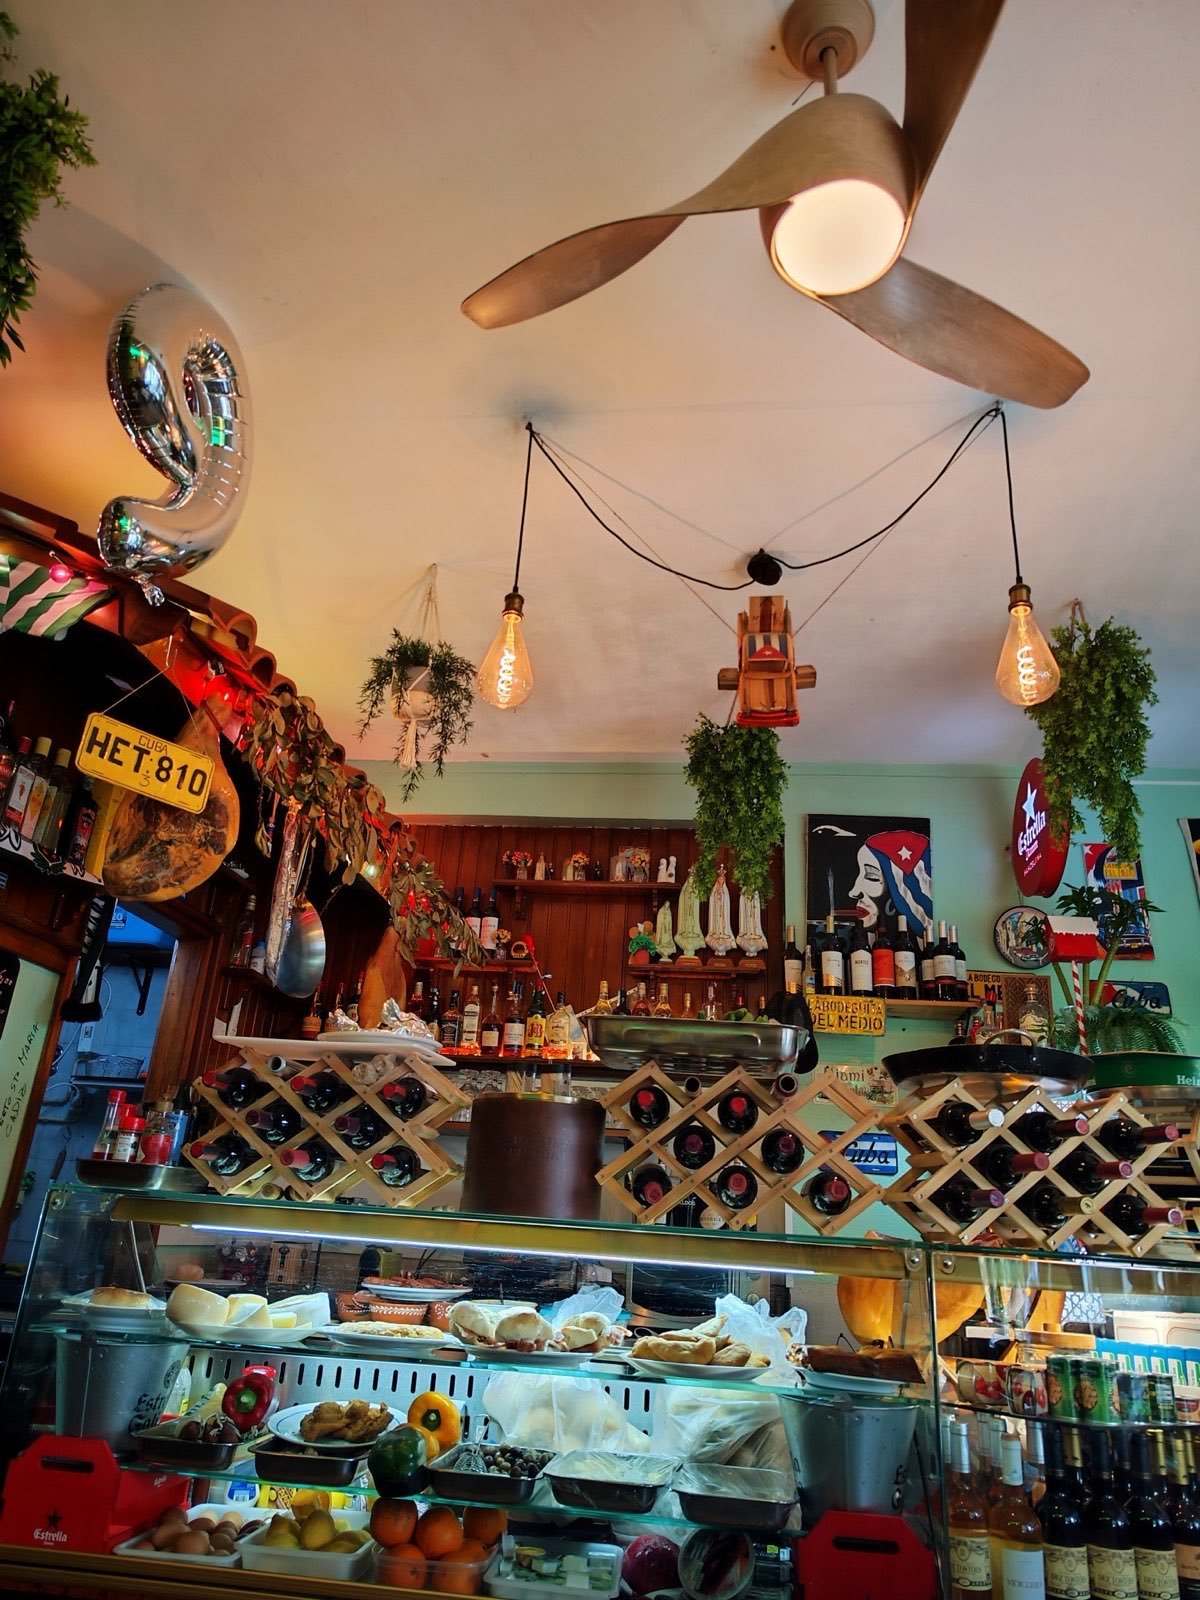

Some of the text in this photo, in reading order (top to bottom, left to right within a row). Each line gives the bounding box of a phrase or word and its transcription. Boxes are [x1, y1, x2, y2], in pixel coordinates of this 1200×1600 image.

[138, 735, 168, 755] CUBA
[1018, 810, 1046, 856] Estrella
[811, 1013, 884, 1031] DEL MEDIO
[17, 1020, 40, 1066] MARIA
[5, 1083, 27, 1138] CADIZ
[841, 1141, 890, 1165] Cuba
[33, 1528, 68, 1543] Estrella
